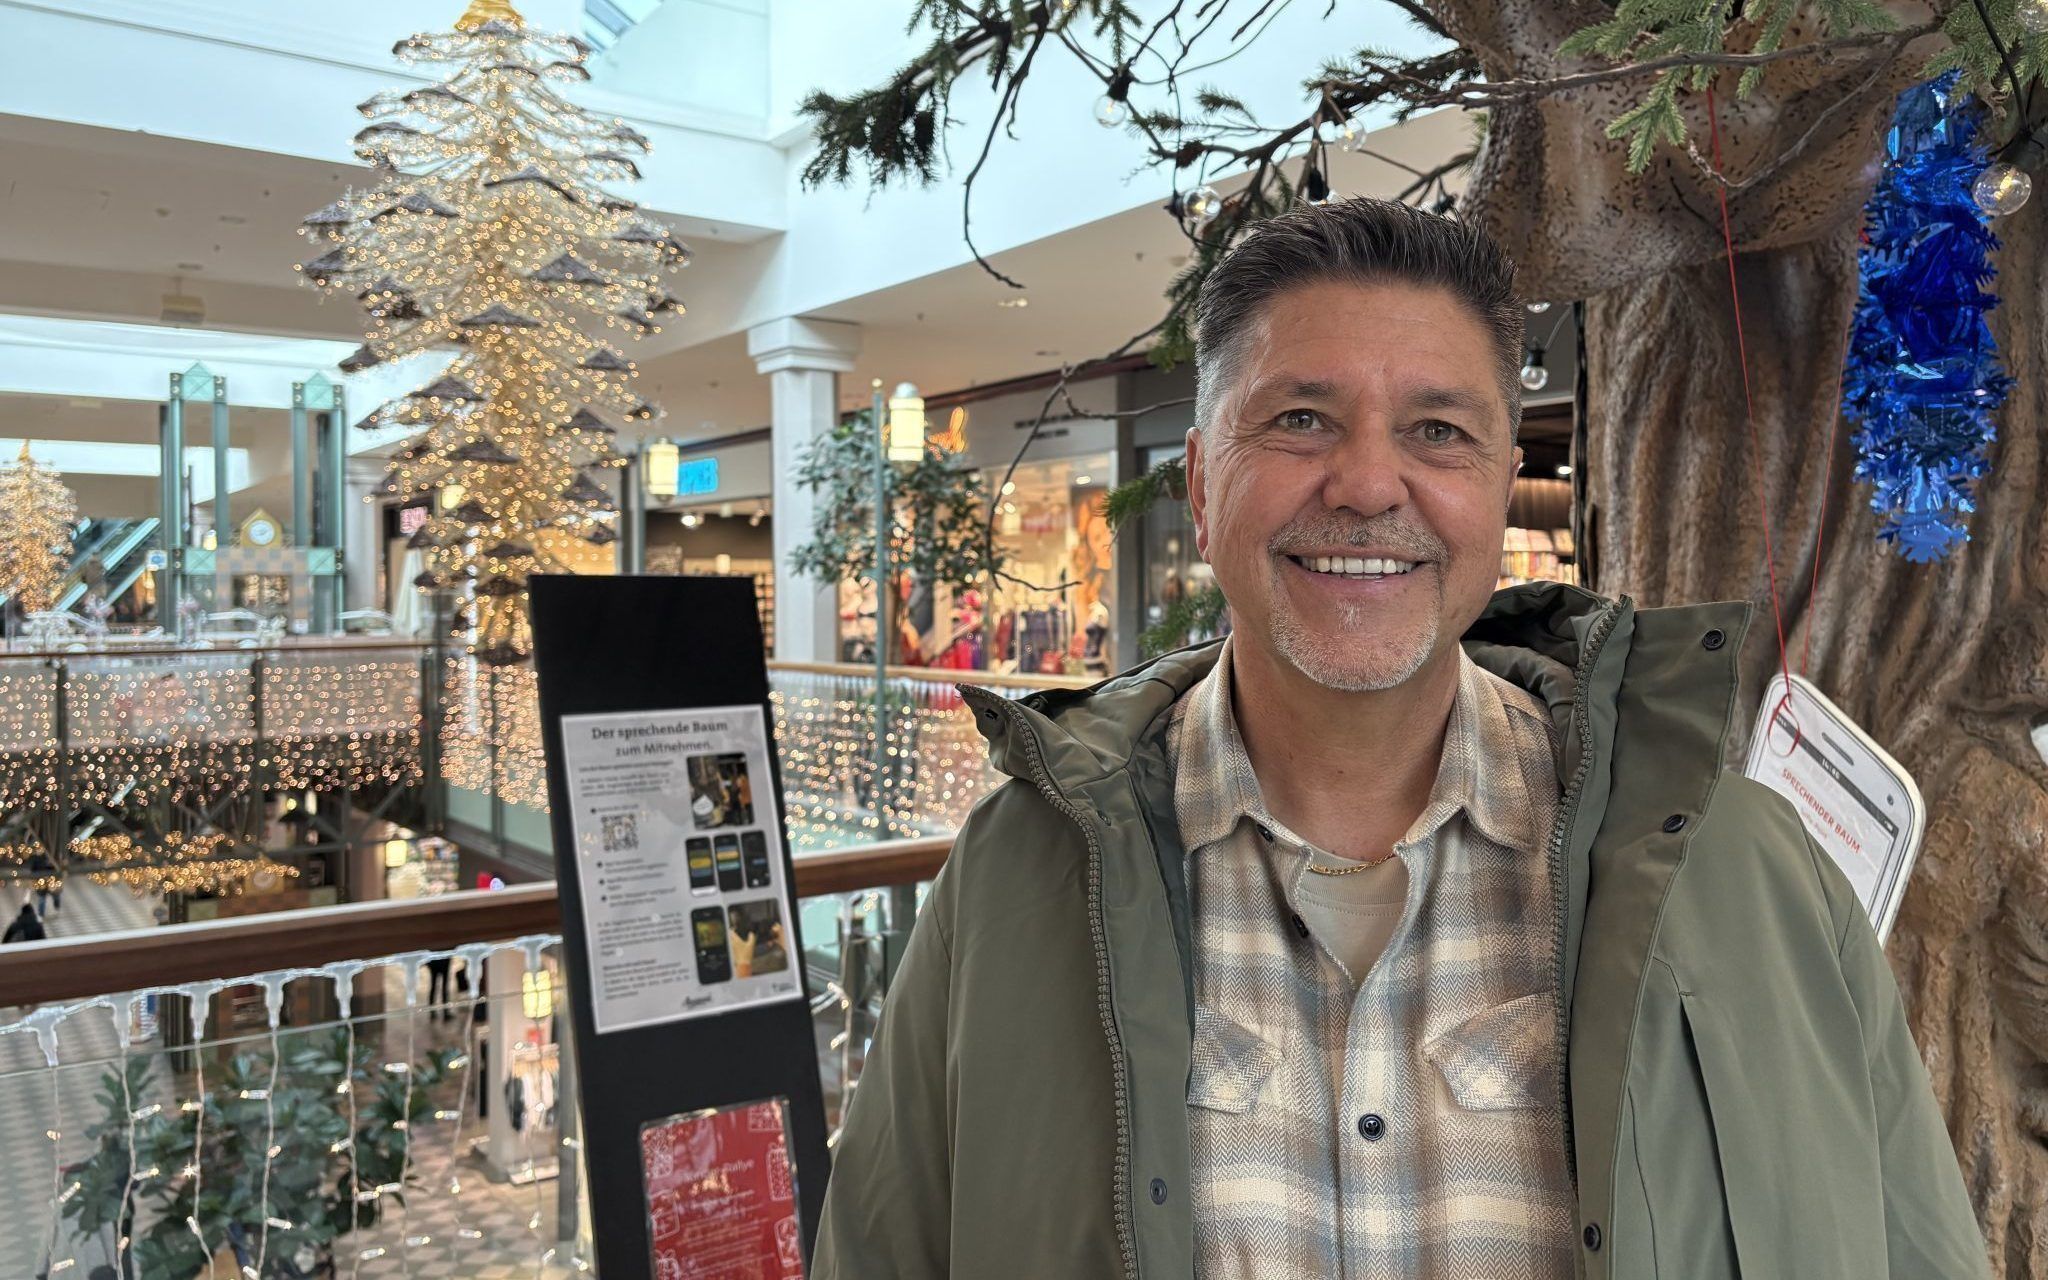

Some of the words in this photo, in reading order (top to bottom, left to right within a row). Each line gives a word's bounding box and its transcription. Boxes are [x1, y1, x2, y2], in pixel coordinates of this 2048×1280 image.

[592, 726, 614, 739] Der
[618, 722, 689, 740] sprechende
[692, 721, 727, 734] Baum
[616, 746, 640, 757] zum
[1782, 769, 1834, 827] SPRECHENDER
[1835, 824, 1861, 853] BAUM
